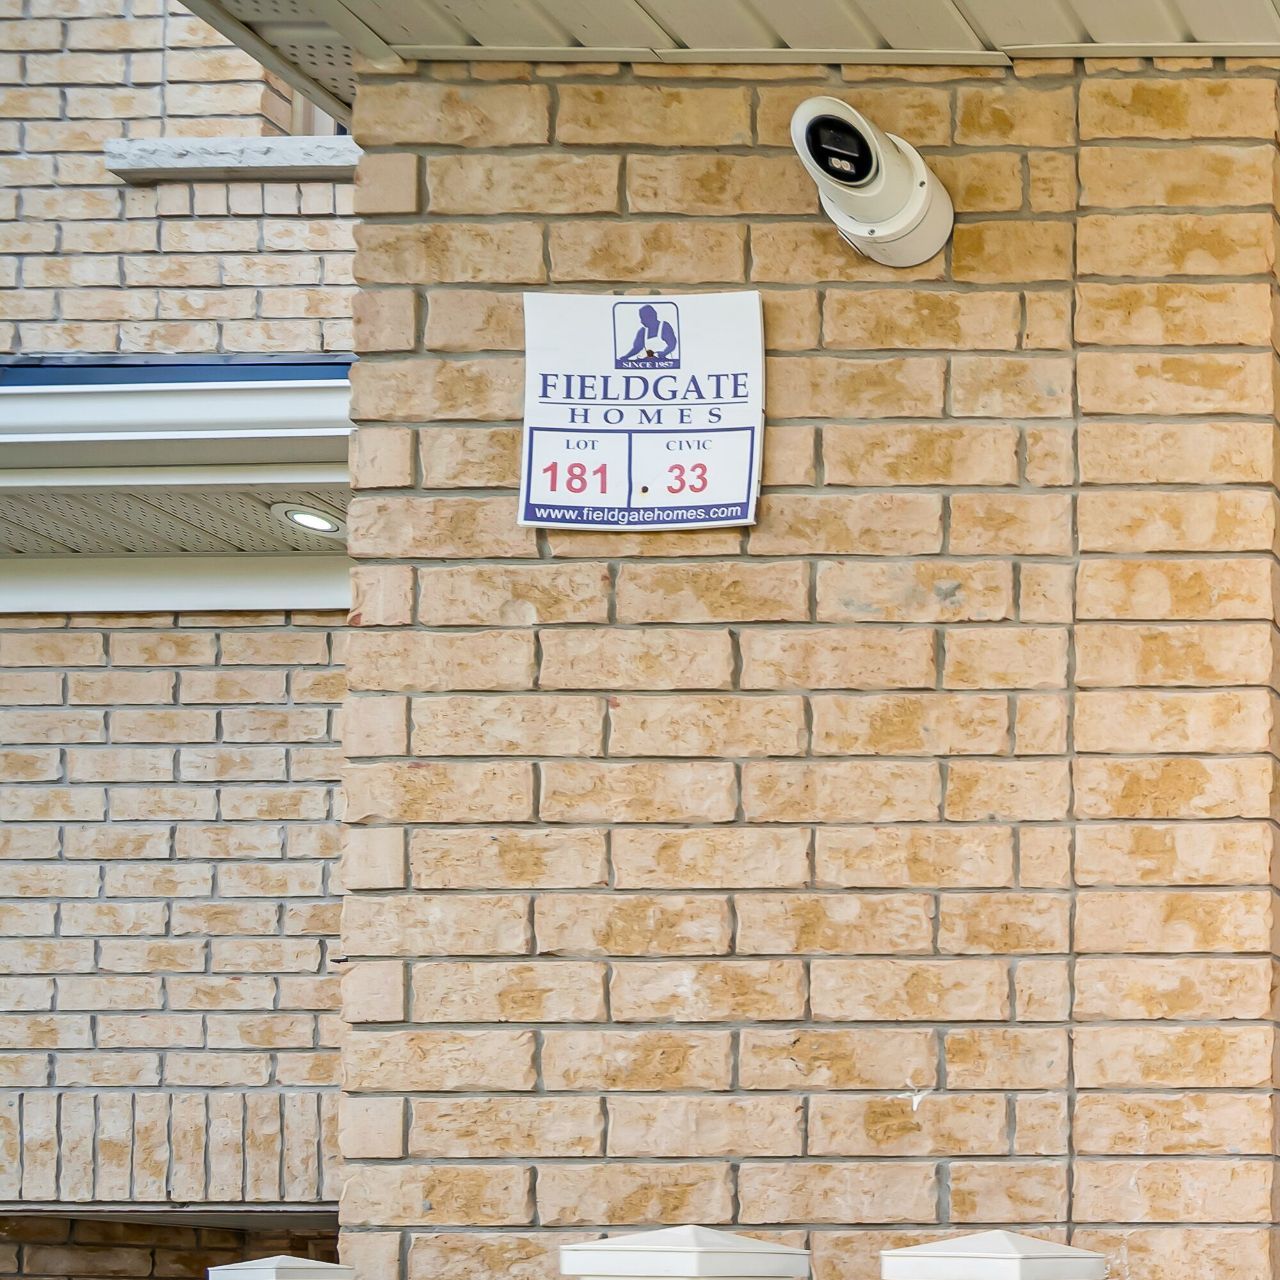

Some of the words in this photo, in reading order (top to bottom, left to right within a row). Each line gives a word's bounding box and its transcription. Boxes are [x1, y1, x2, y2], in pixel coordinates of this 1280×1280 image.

[622, 361, 653, 369] SINCE
[538, 373, 750, 401] FIELDGATE
[568, 407, 723, 425] HOMES
[565, 439, 600, 451] LOT
[666, 439, 713, 451] CIVIC
[542, 461, 608, 495] 181
[666, 463, 709, 495] 33
[535, 505, 742, 525] www.fieldgatehomes.com
